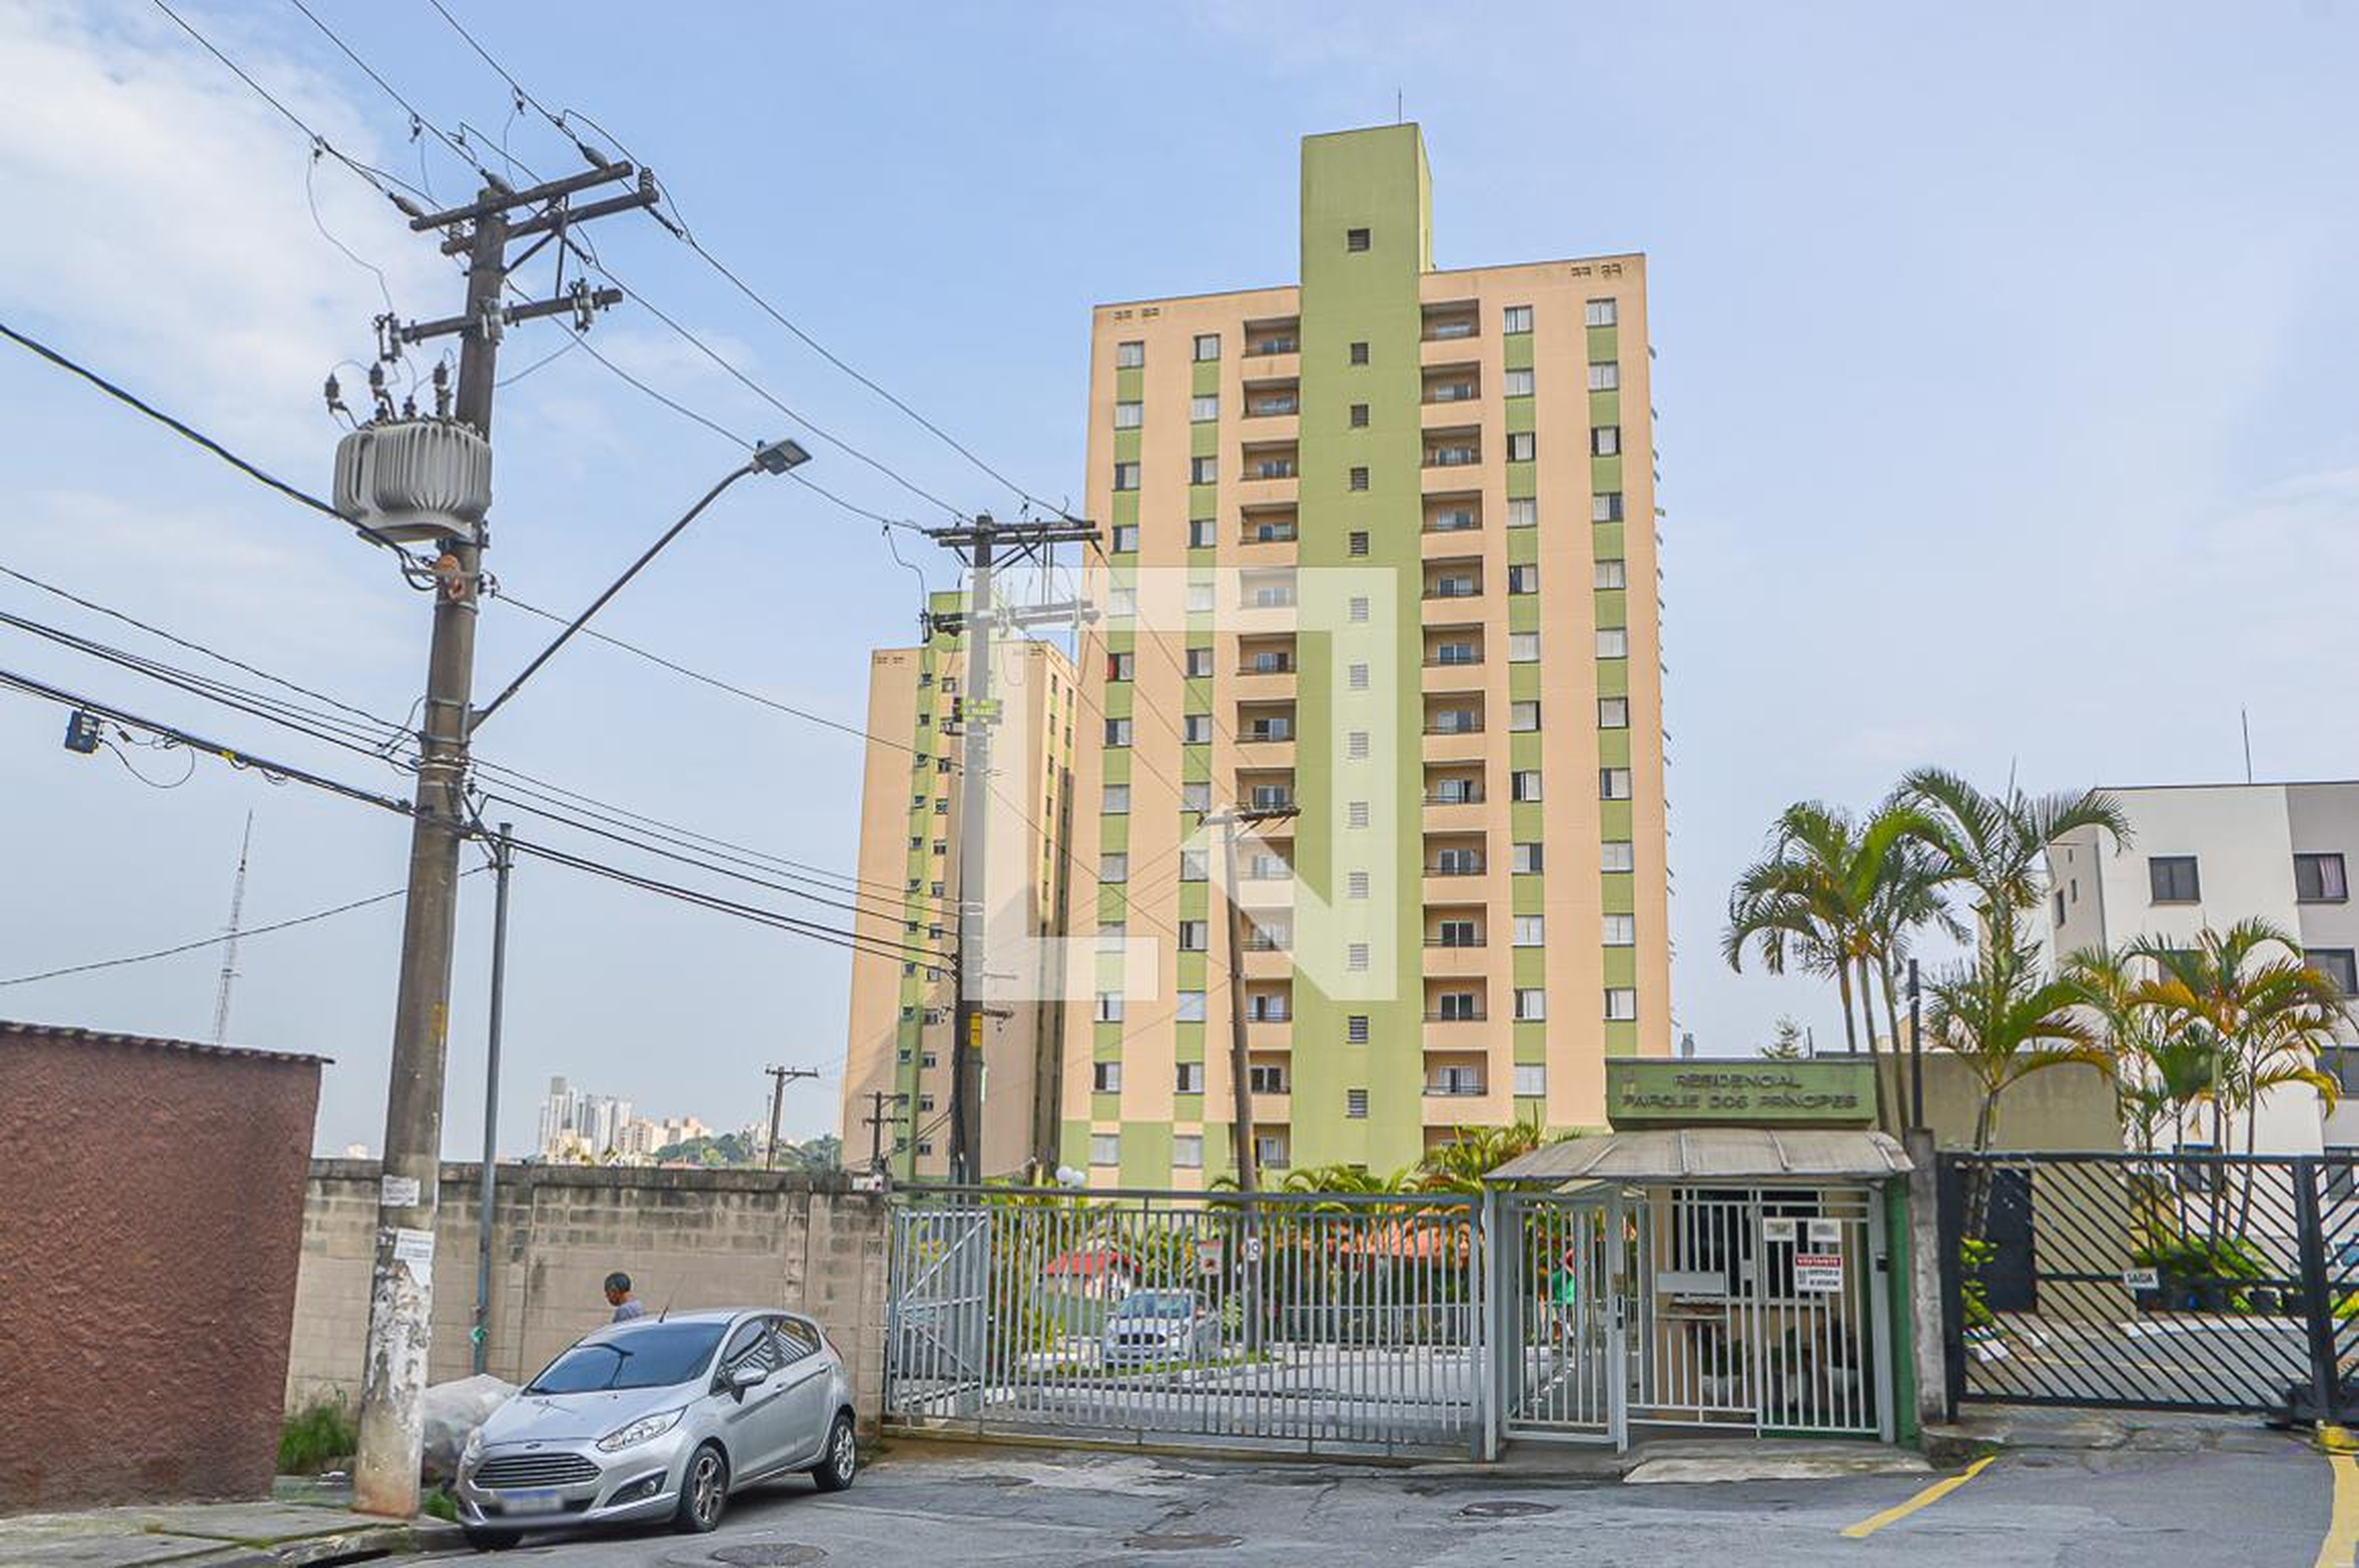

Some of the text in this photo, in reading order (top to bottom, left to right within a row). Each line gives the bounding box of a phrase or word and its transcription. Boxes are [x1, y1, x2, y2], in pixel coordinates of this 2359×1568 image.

[1674, 1074, 1803, 1089] RESIDENCIAL
[1621, 1094, 1700, 1110] PARQUE
[1708, 1094, 1750, 1110] DOS
